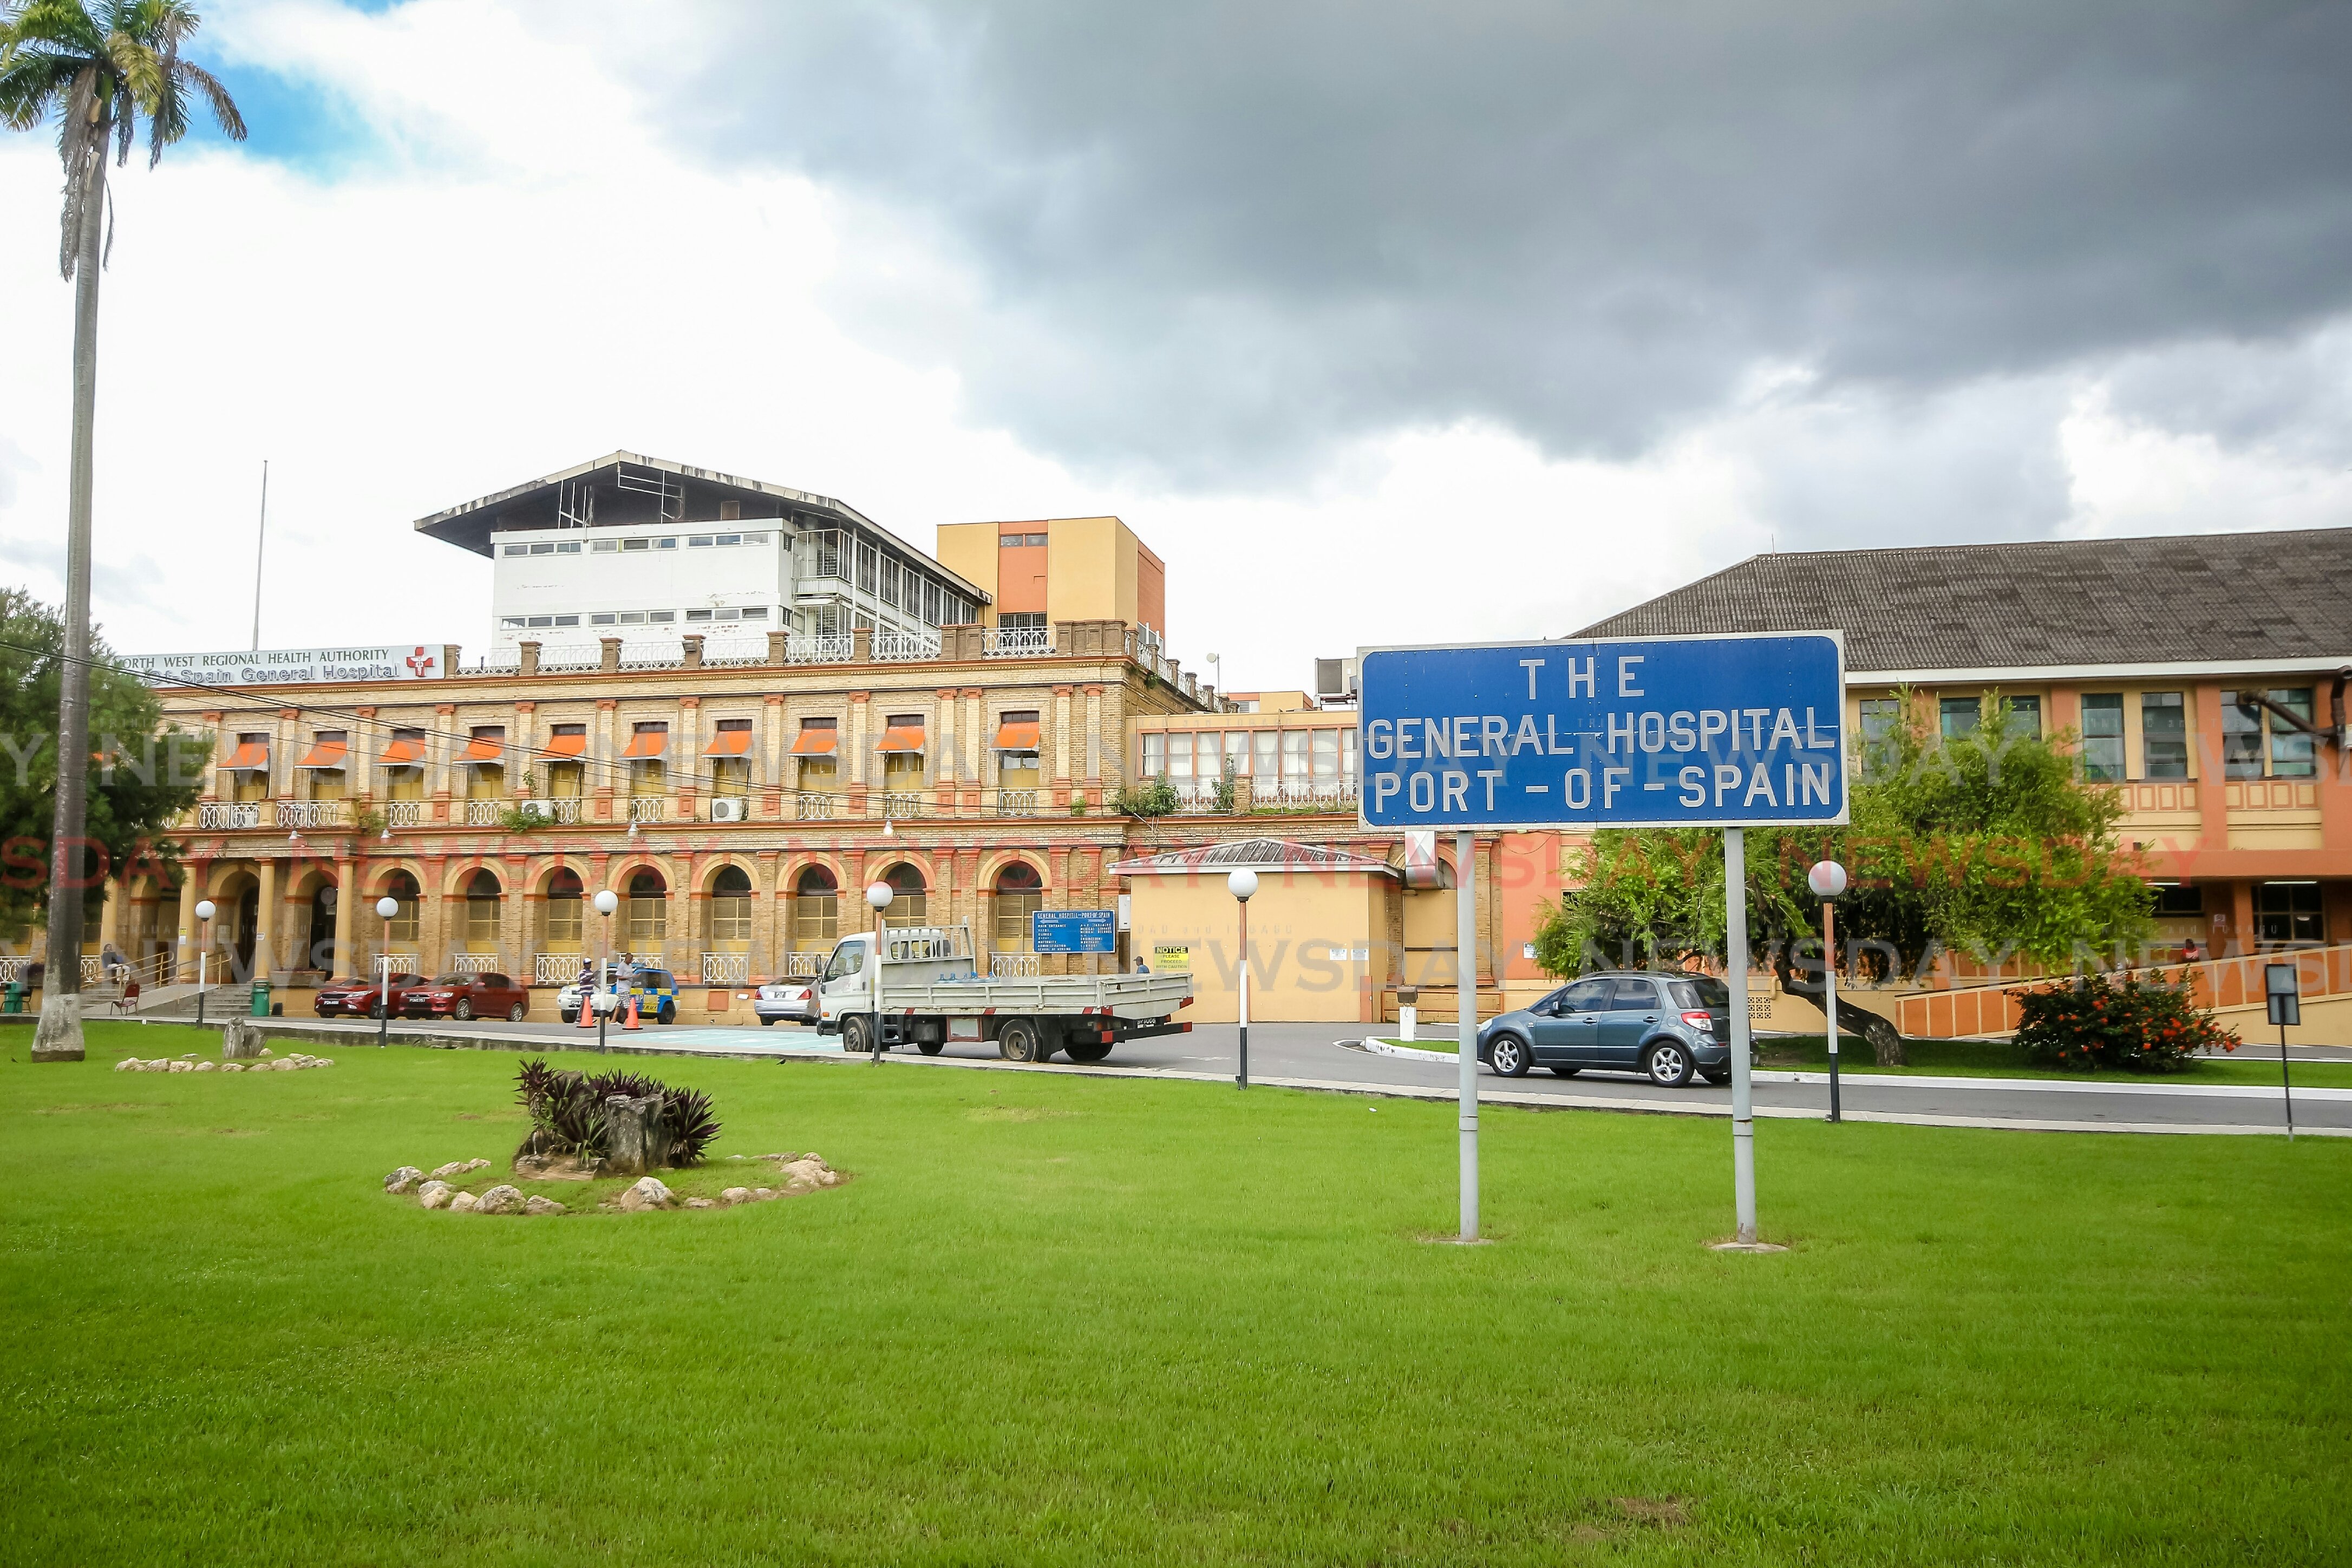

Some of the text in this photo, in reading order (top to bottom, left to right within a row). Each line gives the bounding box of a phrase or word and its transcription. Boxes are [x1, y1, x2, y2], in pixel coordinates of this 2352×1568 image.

[118, 649, 389, 669] ORTH WEST REGIONAL HEALTH AUTHORITY
[241, 665, 315, 682] General
[323, 663, 400, 681] Hospital
[1519, 655, 1645, 700] THE
[1368, 707, 1835, 759] GENERAL HOSPITAL
[1374, 769, 1503, 813] PORT
[1564, 767, 1630, 809] OF
[1679, 762, 1830, 808] SPAIN
